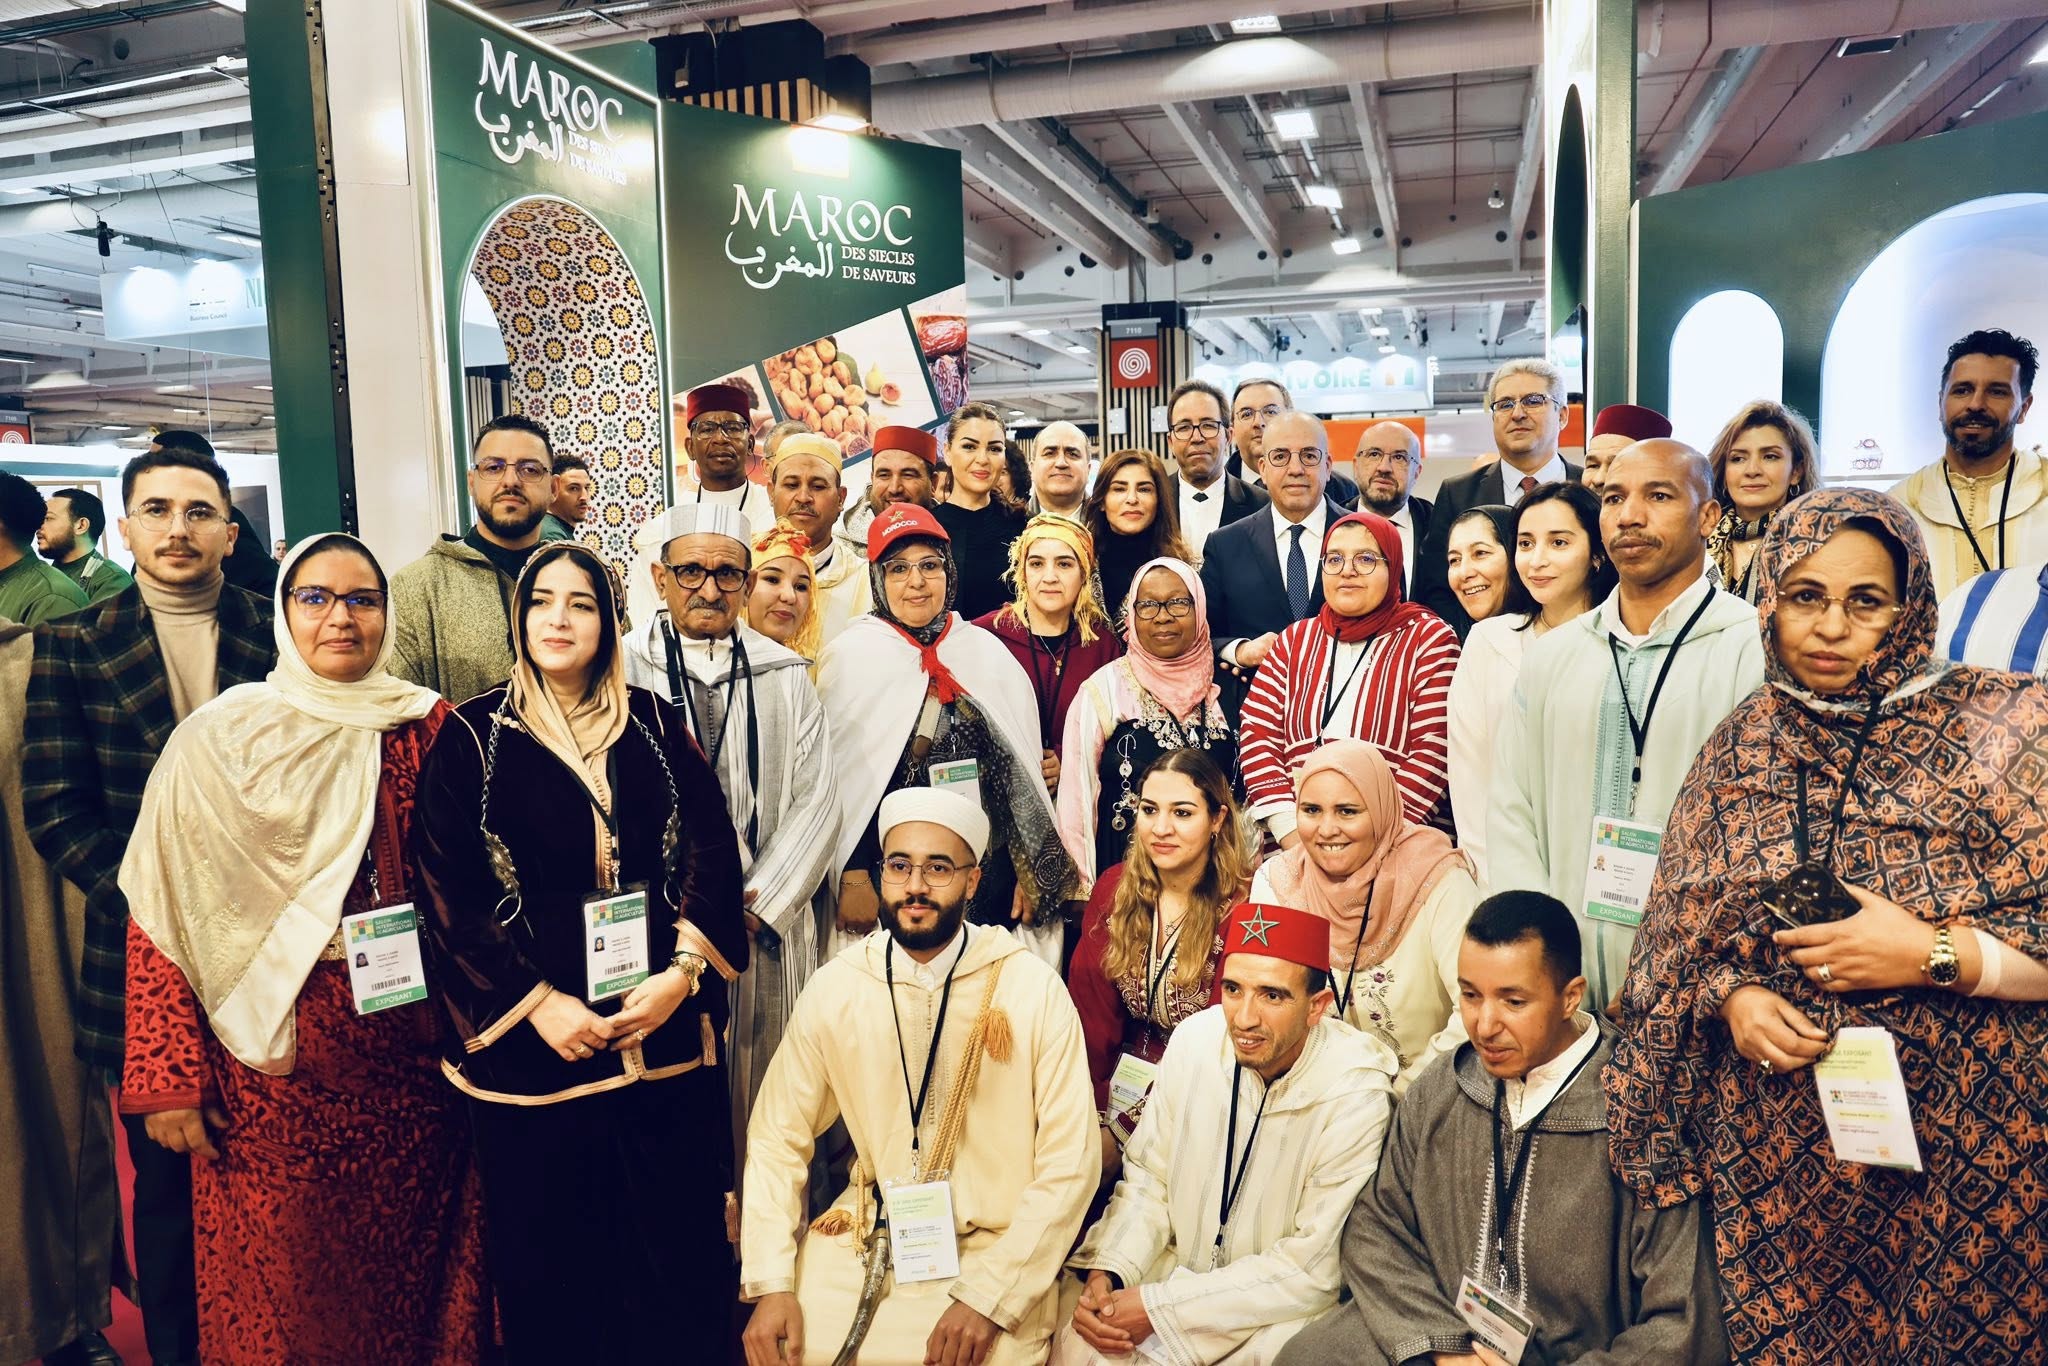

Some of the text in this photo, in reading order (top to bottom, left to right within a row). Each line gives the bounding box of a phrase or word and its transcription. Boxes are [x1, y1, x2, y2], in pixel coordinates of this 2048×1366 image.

[478, 38, 623, 143] MAROC
[475, 91, 565, 164] المغرب
[730, 183, 913, 246] MAROC
[725, 231, 834, 290] المغرب
[841, 245, 915, 266] DES SIECLES
[842, 265, 917, 285] DE SAVEURS
[190, 314, 209, 322] Business
[881, 520, 918, 537] MOROCCO
[1599, 906, 1636, 921] EXPOSANT
[606, 976, 638, 990] EXPOSANT
[375, 991, 413, 1006] EXPOSANT
